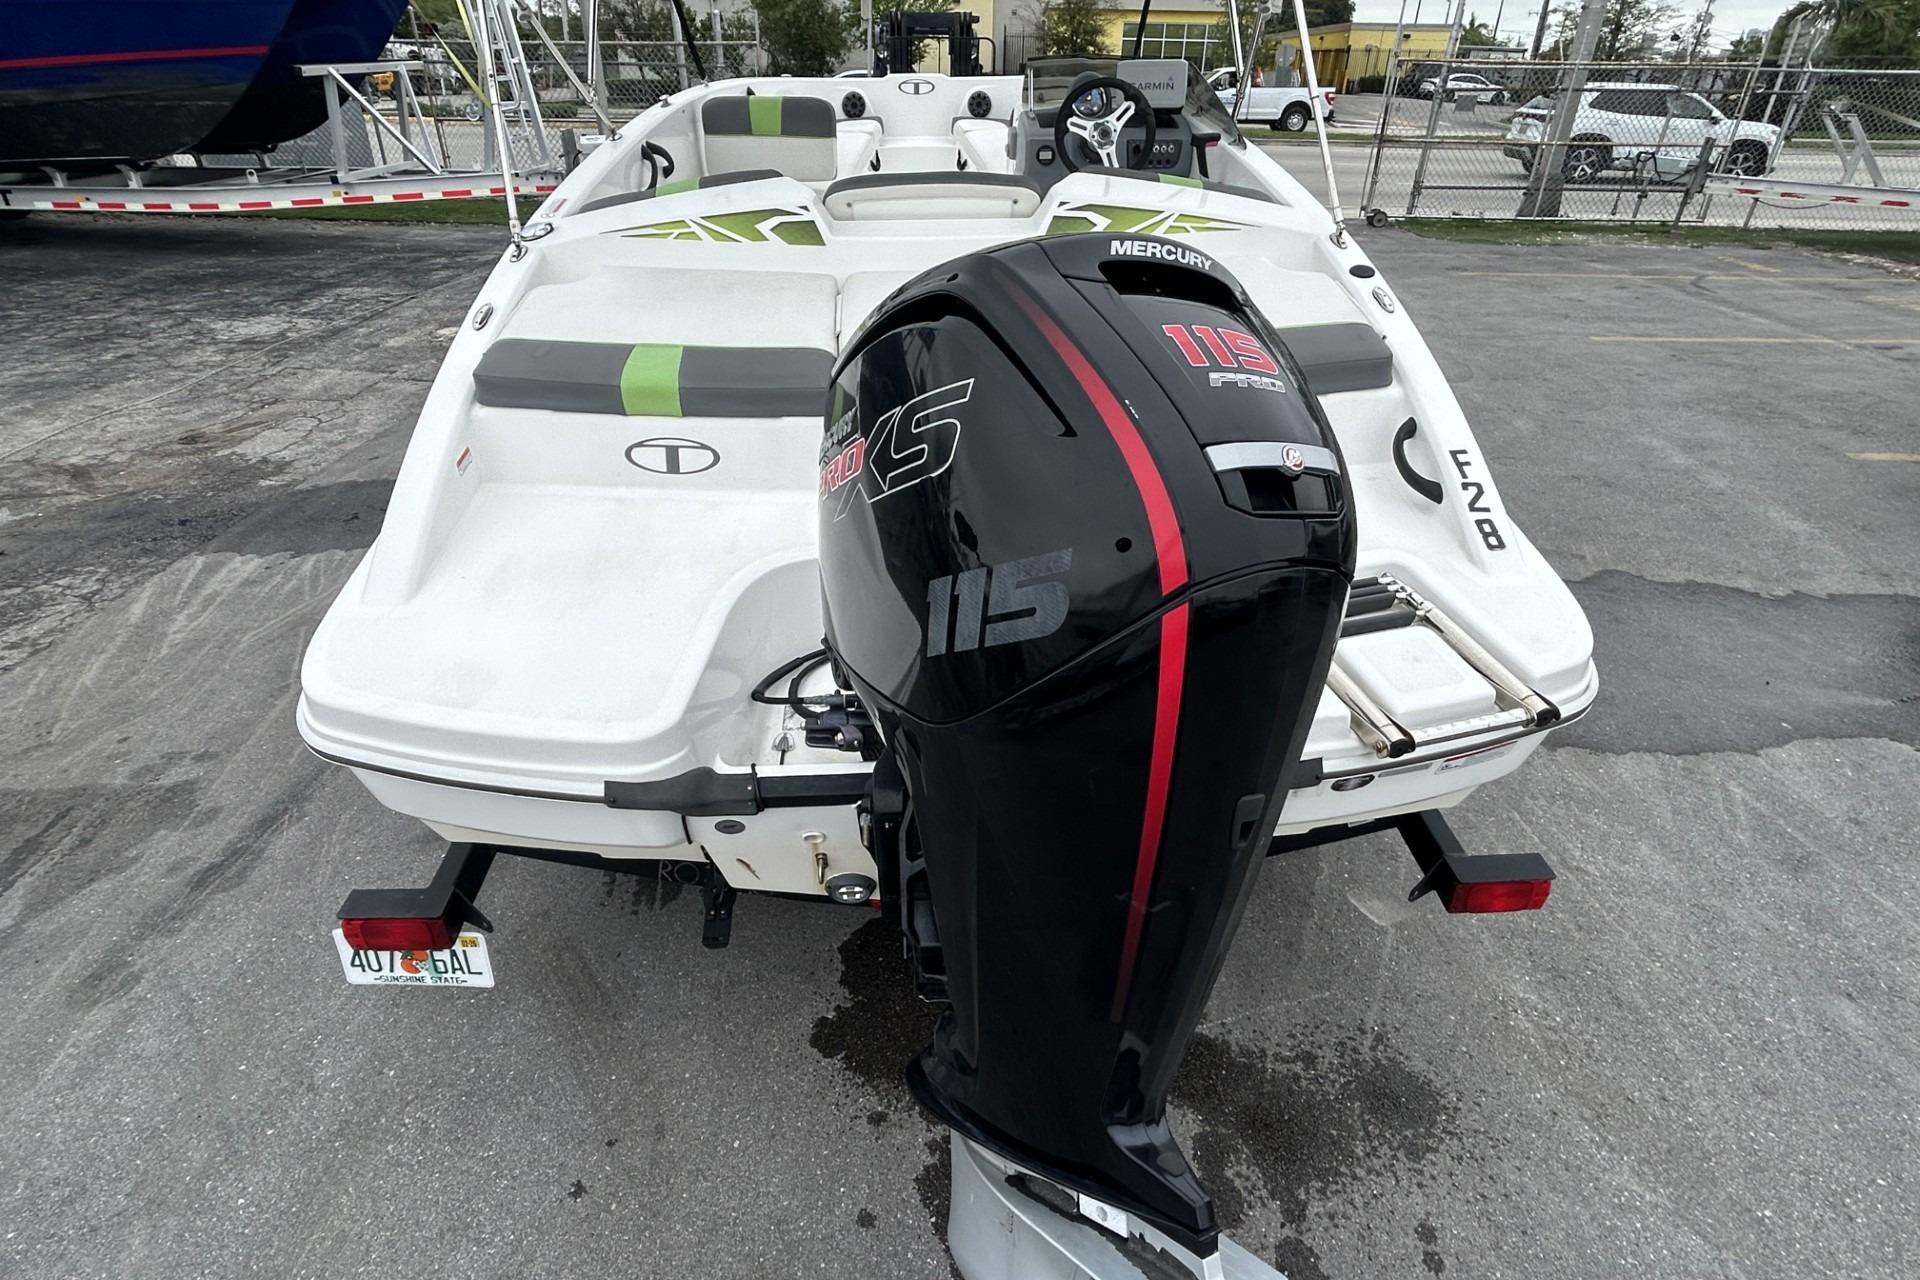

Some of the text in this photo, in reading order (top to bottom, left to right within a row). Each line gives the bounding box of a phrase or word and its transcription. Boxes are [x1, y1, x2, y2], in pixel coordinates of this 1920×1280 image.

[1131, 81, 1175, 91] ARMIN
[1110, 239, 1212, 271] MERCURY
[1162, 324, 1279, 375] 115
[1208, 372, 1286, 393] PRO
[1449, 449, 1506, 551] F28
[926, 547, 1073, 657] 115
